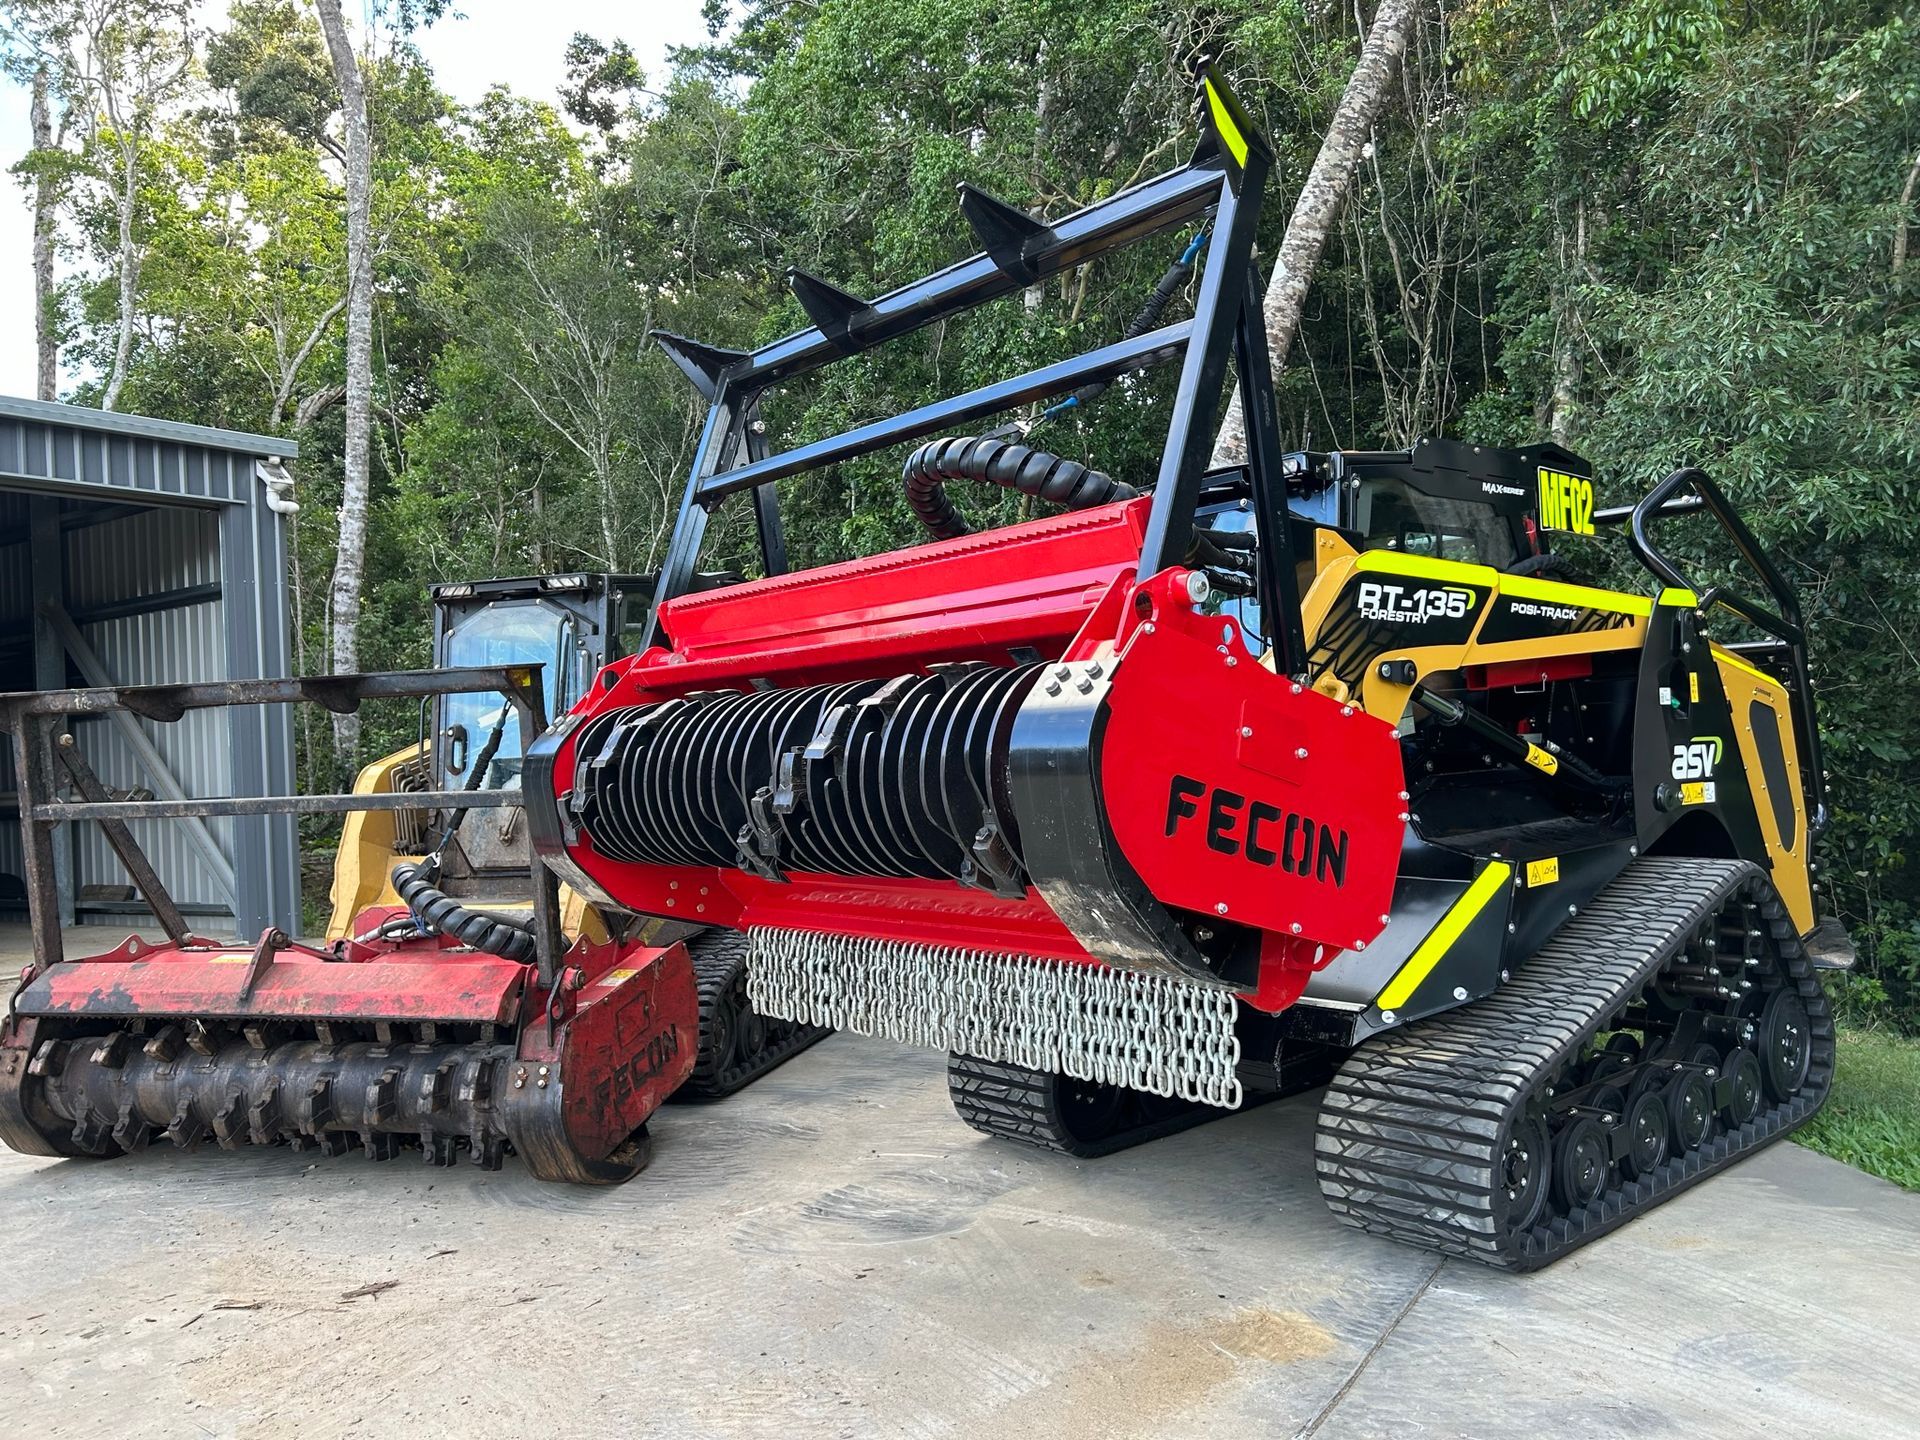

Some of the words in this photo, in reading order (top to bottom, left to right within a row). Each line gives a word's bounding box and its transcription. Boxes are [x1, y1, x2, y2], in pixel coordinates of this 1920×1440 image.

[1540, 469, 1595, 535] MF02
[1357, 582, 1467, 618] RT-135
[1360, 607, 1430, 624] FORESTRY
[1164, 774, 1349, 889] FECON
[591, 1023, 679, 1124] FECON
